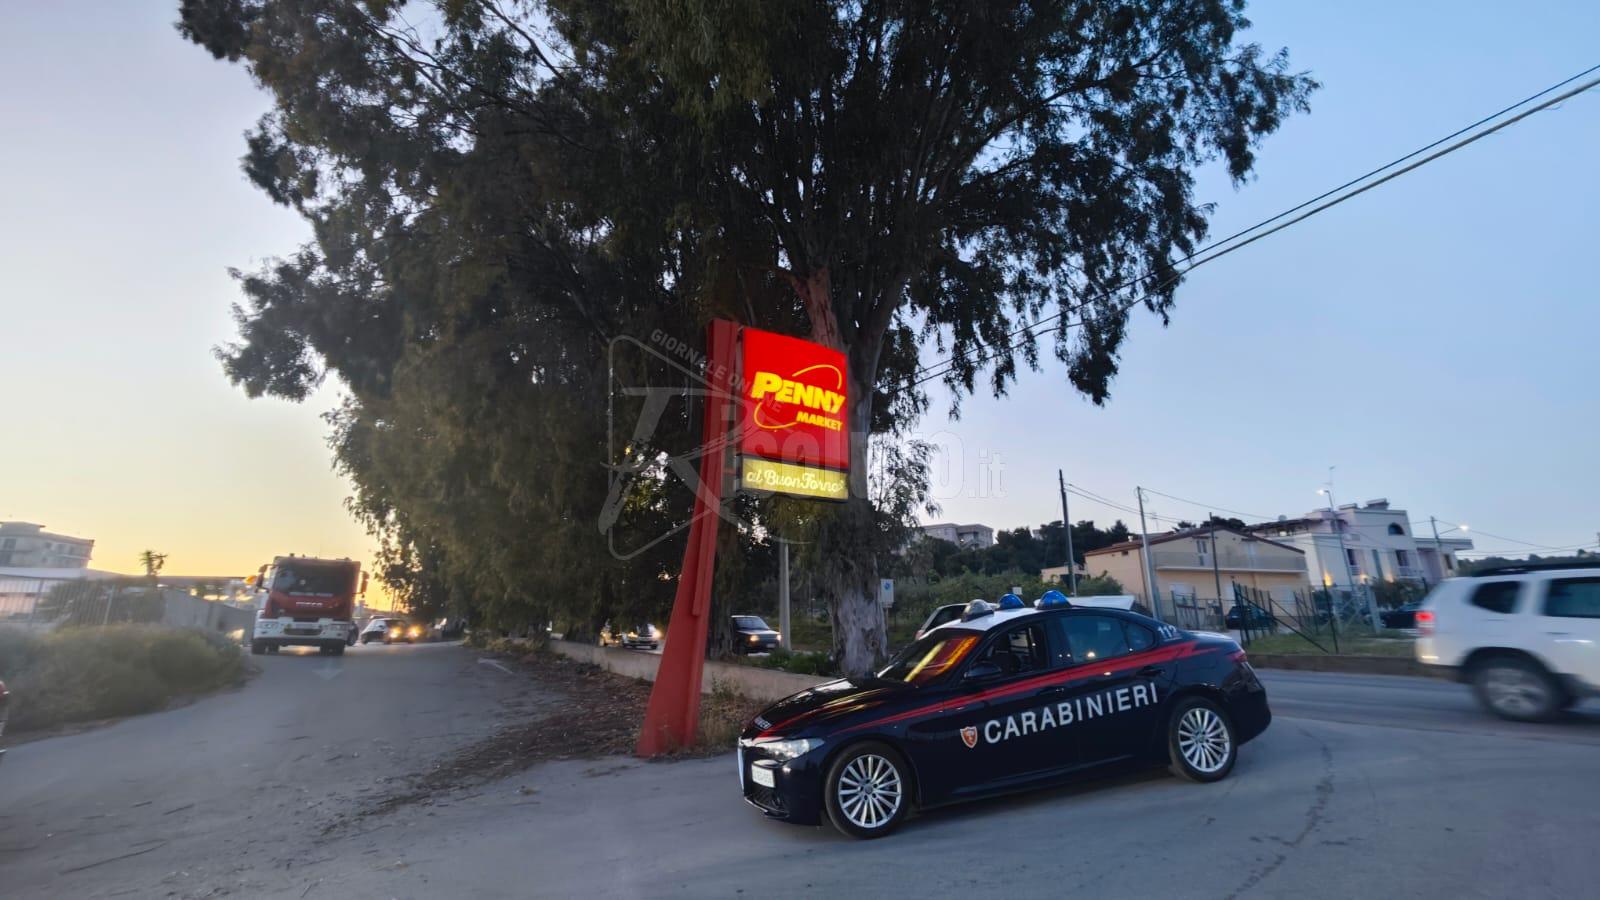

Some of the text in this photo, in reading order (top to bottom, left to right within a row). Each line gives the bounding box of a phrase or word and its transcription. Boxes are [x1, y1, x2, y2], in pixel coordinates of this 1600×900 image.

[751, 371, 846, 414] PENNY
[796, 411, 842, 432] MARKET
[984, 682, 1158, 744] CARABINIERI
